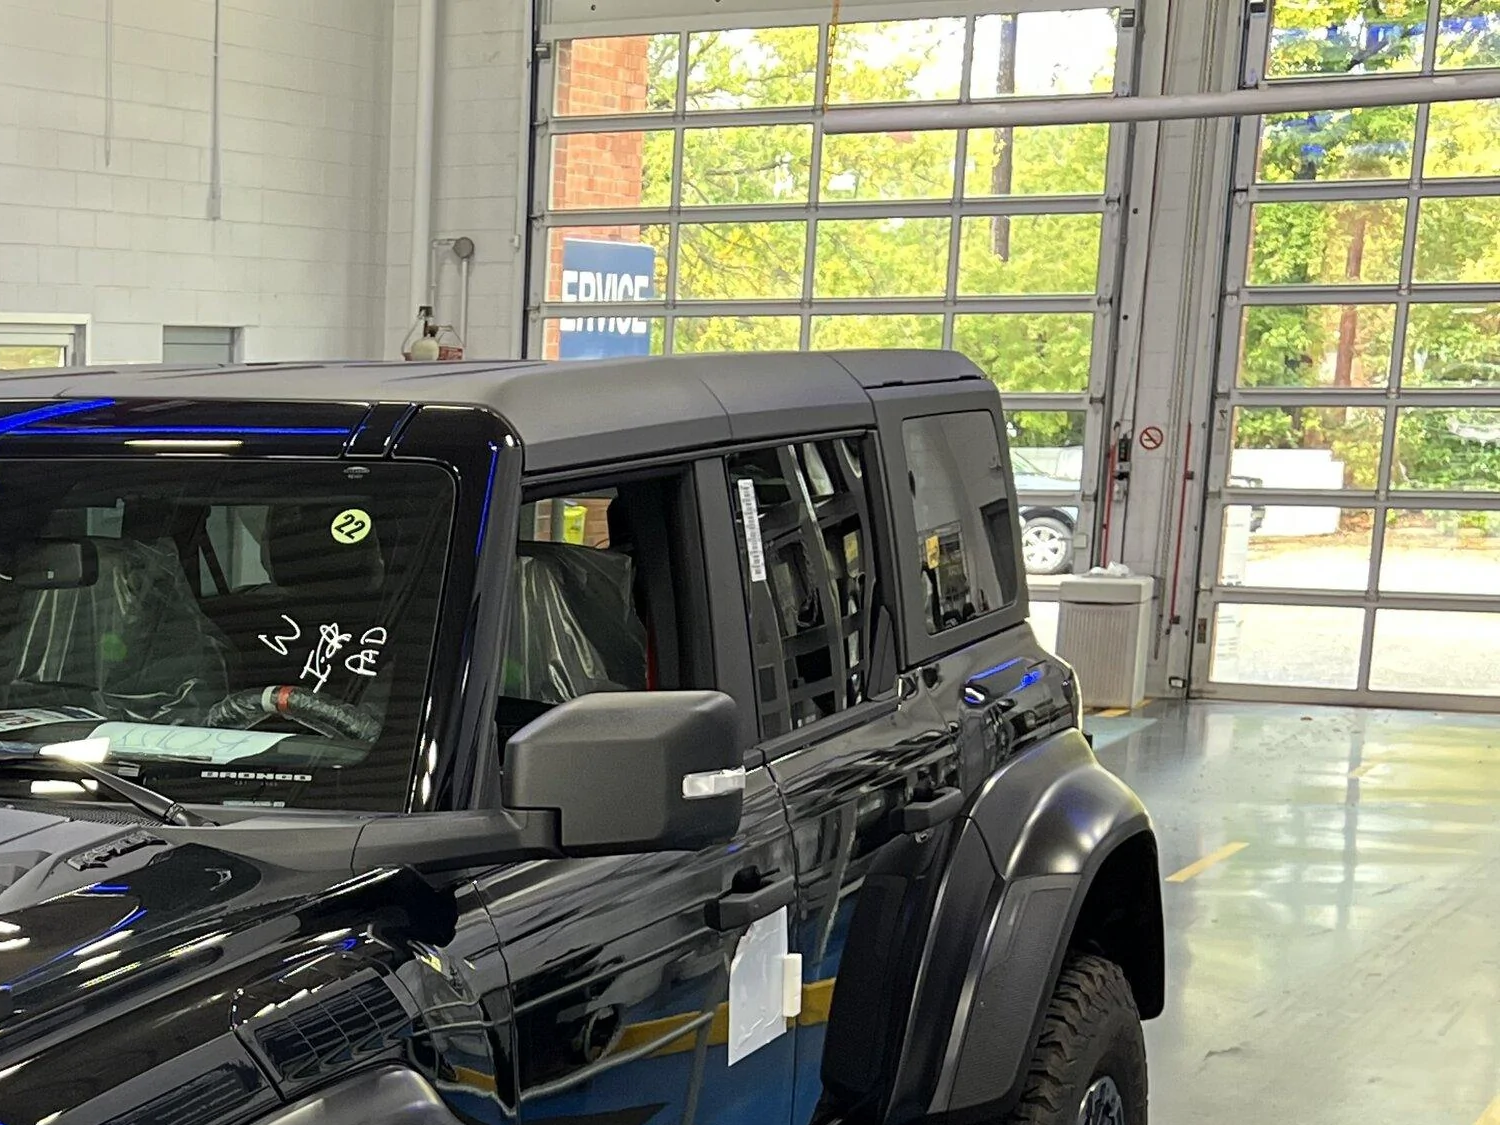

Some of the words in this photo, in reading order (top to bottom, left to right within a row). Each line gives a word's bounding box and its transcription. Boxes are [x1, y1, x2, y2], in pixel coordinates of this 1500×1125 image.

[560, 270, 649, 335] ERVICE
[334, 514, 366, 540] 22
[345, 627, 387, 676] PAD
[201, 771, 312, 781] BRONCO
